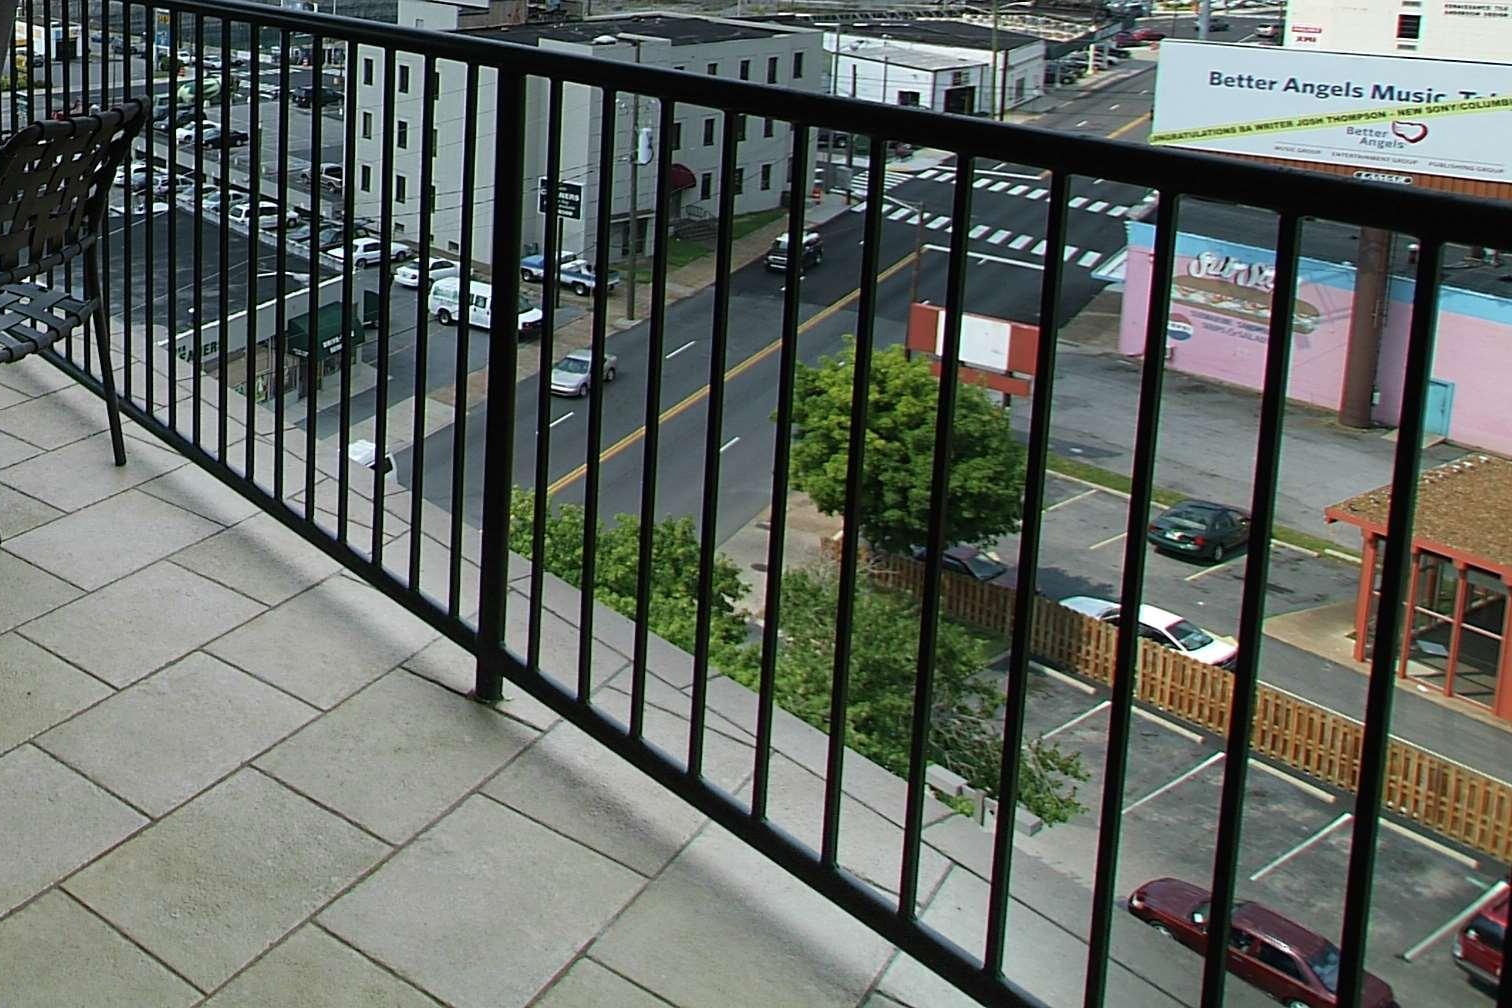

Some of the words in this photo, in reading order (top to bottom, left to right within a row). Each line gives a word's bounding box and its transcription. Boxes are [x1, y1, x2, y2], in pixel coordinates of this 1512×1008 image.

[1209, 71, 1278, 91] Better
[1283, 78, 1364, 99] Angels
[1371, 84, 1447, 104] Music
[1255, 120, 1293, 131] WRITER
[1296, 117, 1324, 127] JOSH
[1326, 111, 1387, 123] THOMPSON
[1397, 108, 1423, 117] NEW
[1346, 126, 1388, 138] Better
[1359, 137, 1405, 149] Angels
[1392, 157, 1418, 165] GROUP
[1428, 161, 1474, 171] PUBLISHING
